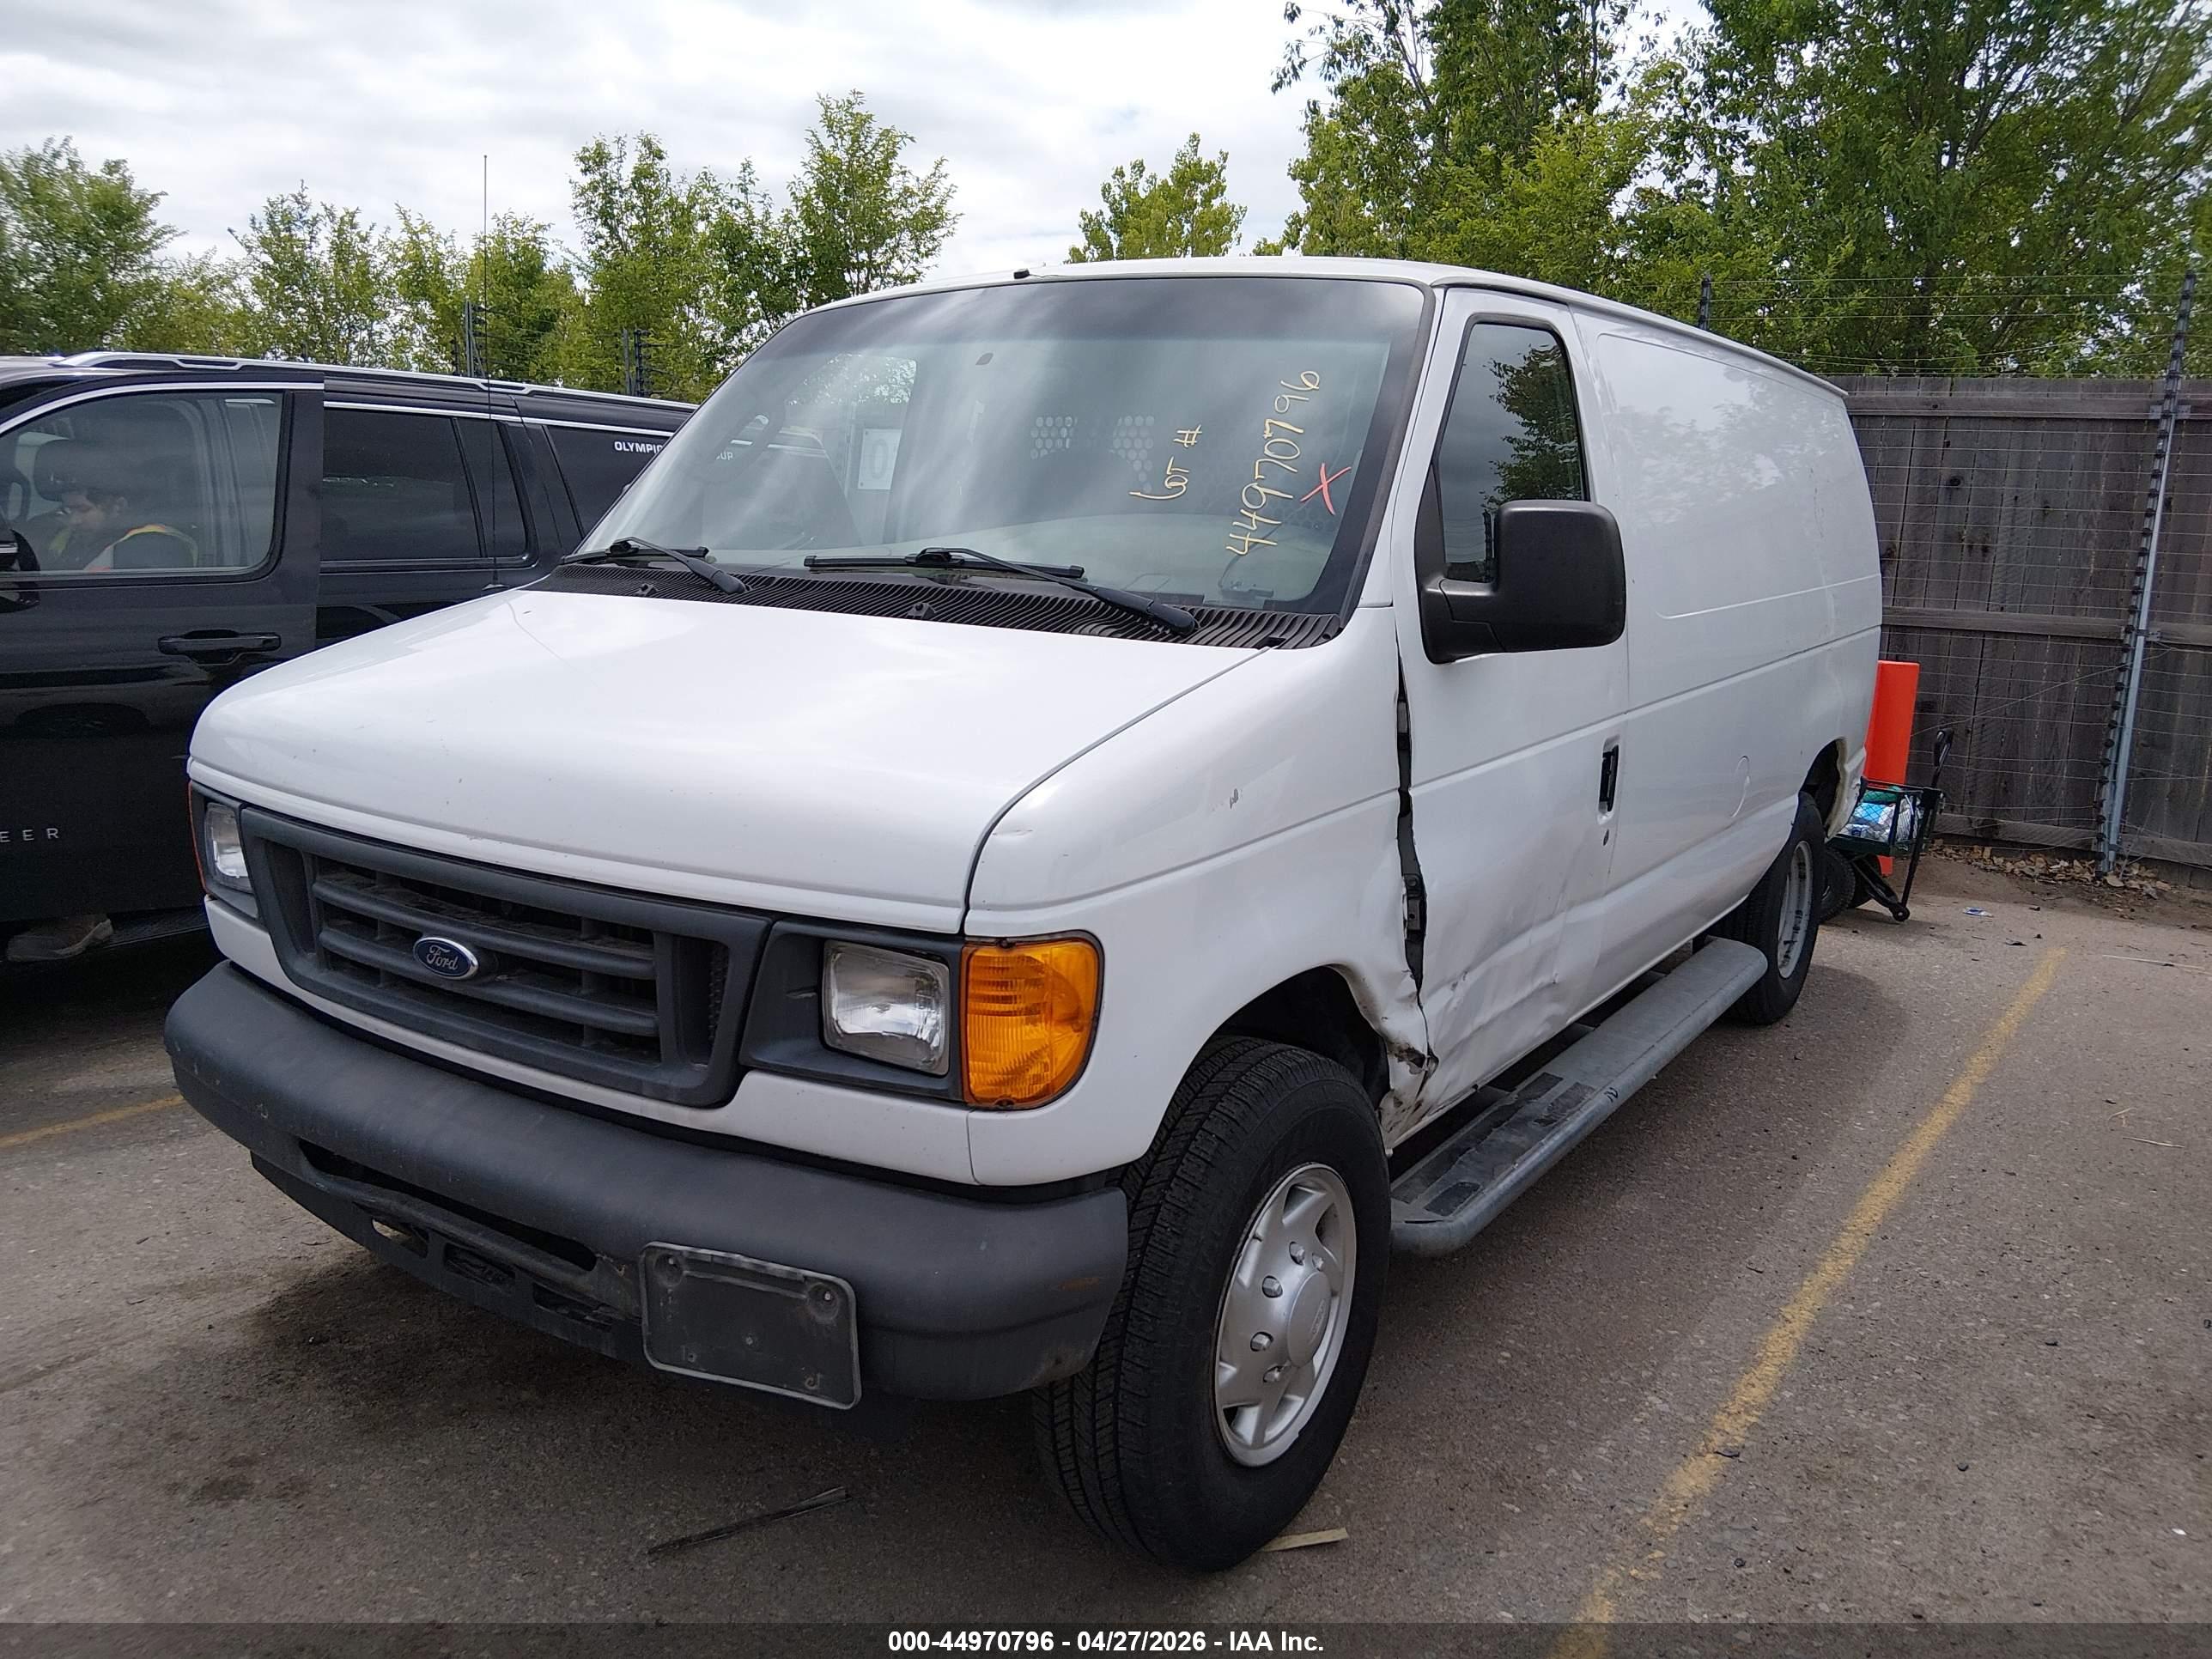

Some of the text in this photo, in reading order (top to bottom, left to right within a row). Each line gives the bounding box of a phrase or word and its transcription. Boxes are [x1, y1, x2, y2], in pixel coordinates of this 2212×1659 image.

[1173, 424, 1202, 447] #
[716, 451, 734, 461] UP
[1225, 370, 1320, 556] 44970796
[426, 945, 459, 970] Ford
